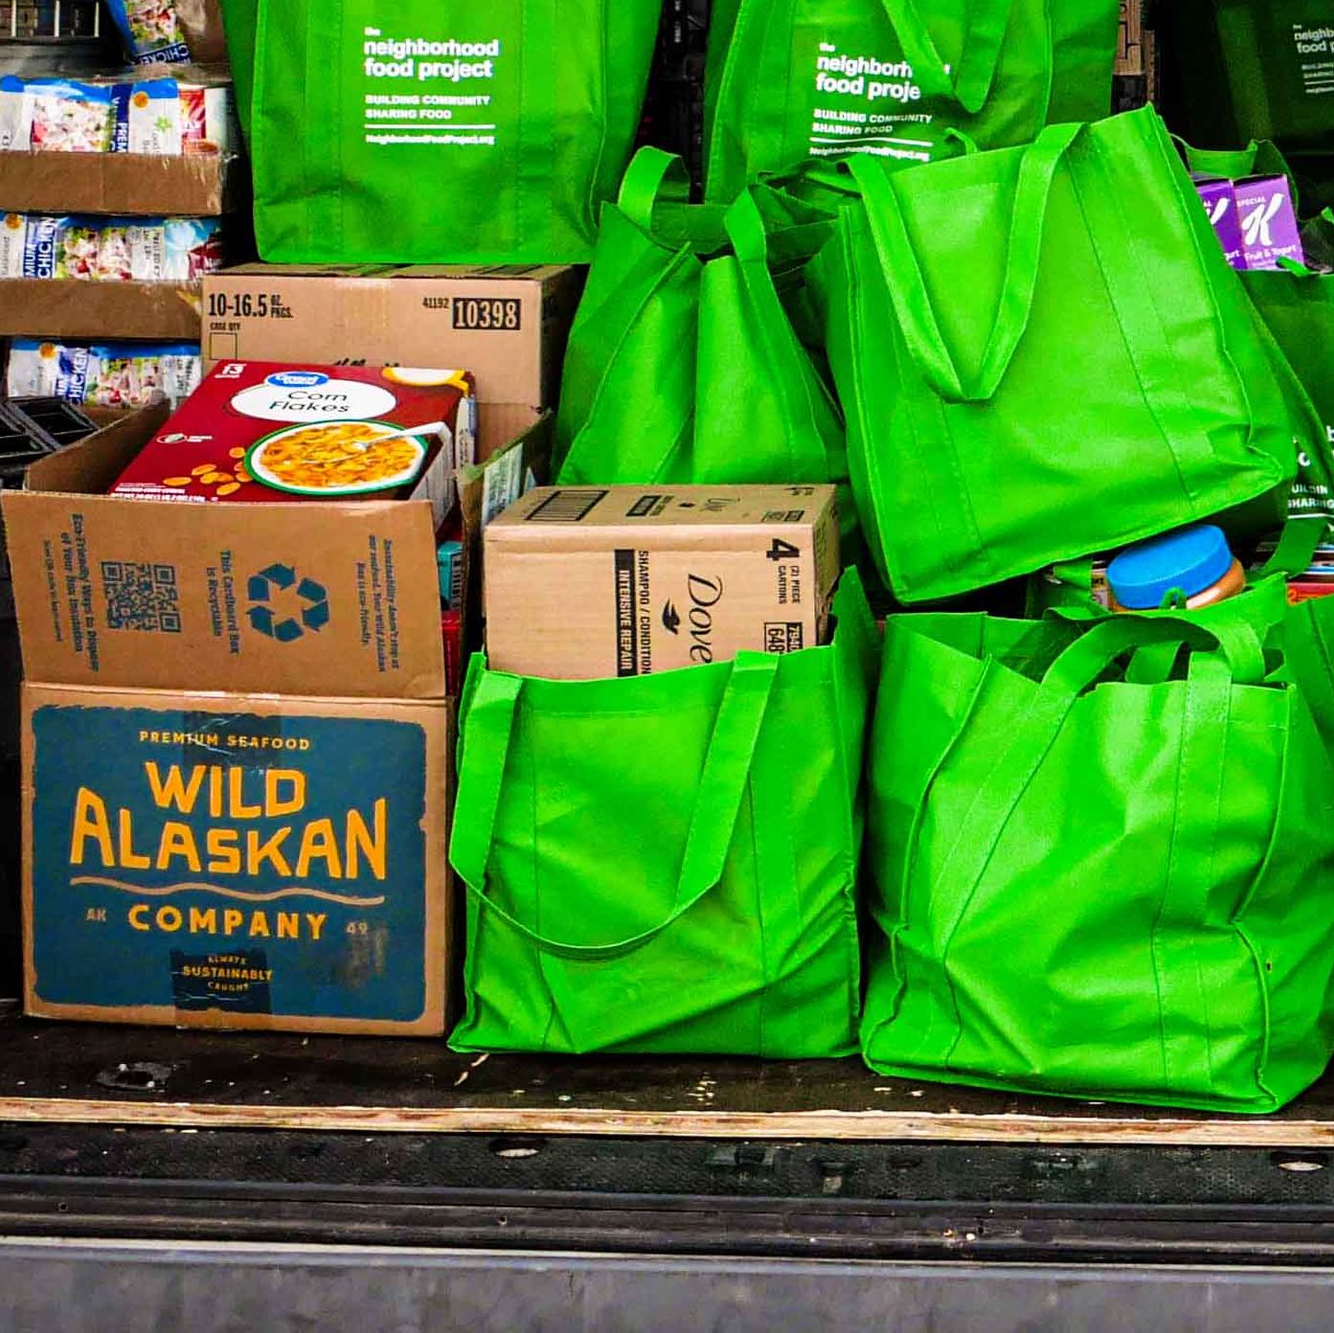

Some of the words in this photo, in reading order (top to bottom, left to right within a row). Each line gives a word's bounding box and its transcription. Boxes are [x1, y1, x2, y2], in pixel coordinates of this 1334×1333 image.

[364, 38, 499, 59] neighborhood
[1297, 40, 1327, 53] food
[365, 58, 414, 77] food
[419, 59, 493, 82] project
[816, 72, 864, 94] food
[366, 94, 420, 105] BUILDING
[423, 95, 491, 105] COMMUNITY
[366, 109, 417, 119] SHARING
[420, 109, 452, 119] FOOD
[813, 109, 867, 122] BUILDING
[869, 114, 933, 124] COMMUNITY
[812, 123, 862, 135] SHARING
[864, 125, 893, 134] FOOD
[1241, 193, 1285, 246] K
[38, 217, 55, 279] CHICKEN
[209, 293, 267, 317] 10-16.5
[423, 297, 449, 308] 41192
[455, 300, 518, 328] 10398
[69, 347, 87, 406] CHICKEN
[269, 401, 350, 413] Flakes
[288, 391, 348, 401] Corn
[766, 538, 800, 561] 4
[638, 550, 650, 605] SHAMPOO
[778, 565, 788, 604] CARTONS
[220, 550, 232, 574] This
[230, 633, 240, 655] Box
[618, 570, 632, 627] INTENSIVE
[791, 580, 801, 603] PIECE
[687, 573, 723, 664] Dove
[620, 629, 634, 670] REPAIR
[768, 628, 786, 654] 648
[139, 730, 219, 746] PREMIUM
[227, 734, 310, 751] SEAFOOD
[145, 761, 307, 819] WILD
[70, 786, 386, 881] ALASKAN
[86, 909, 107, 922] AK
[127, 904, 327, 940] COMPANY
[346, 921, 368, 935] 49
[182, 965, 274, 982] SUSTAINABLY
